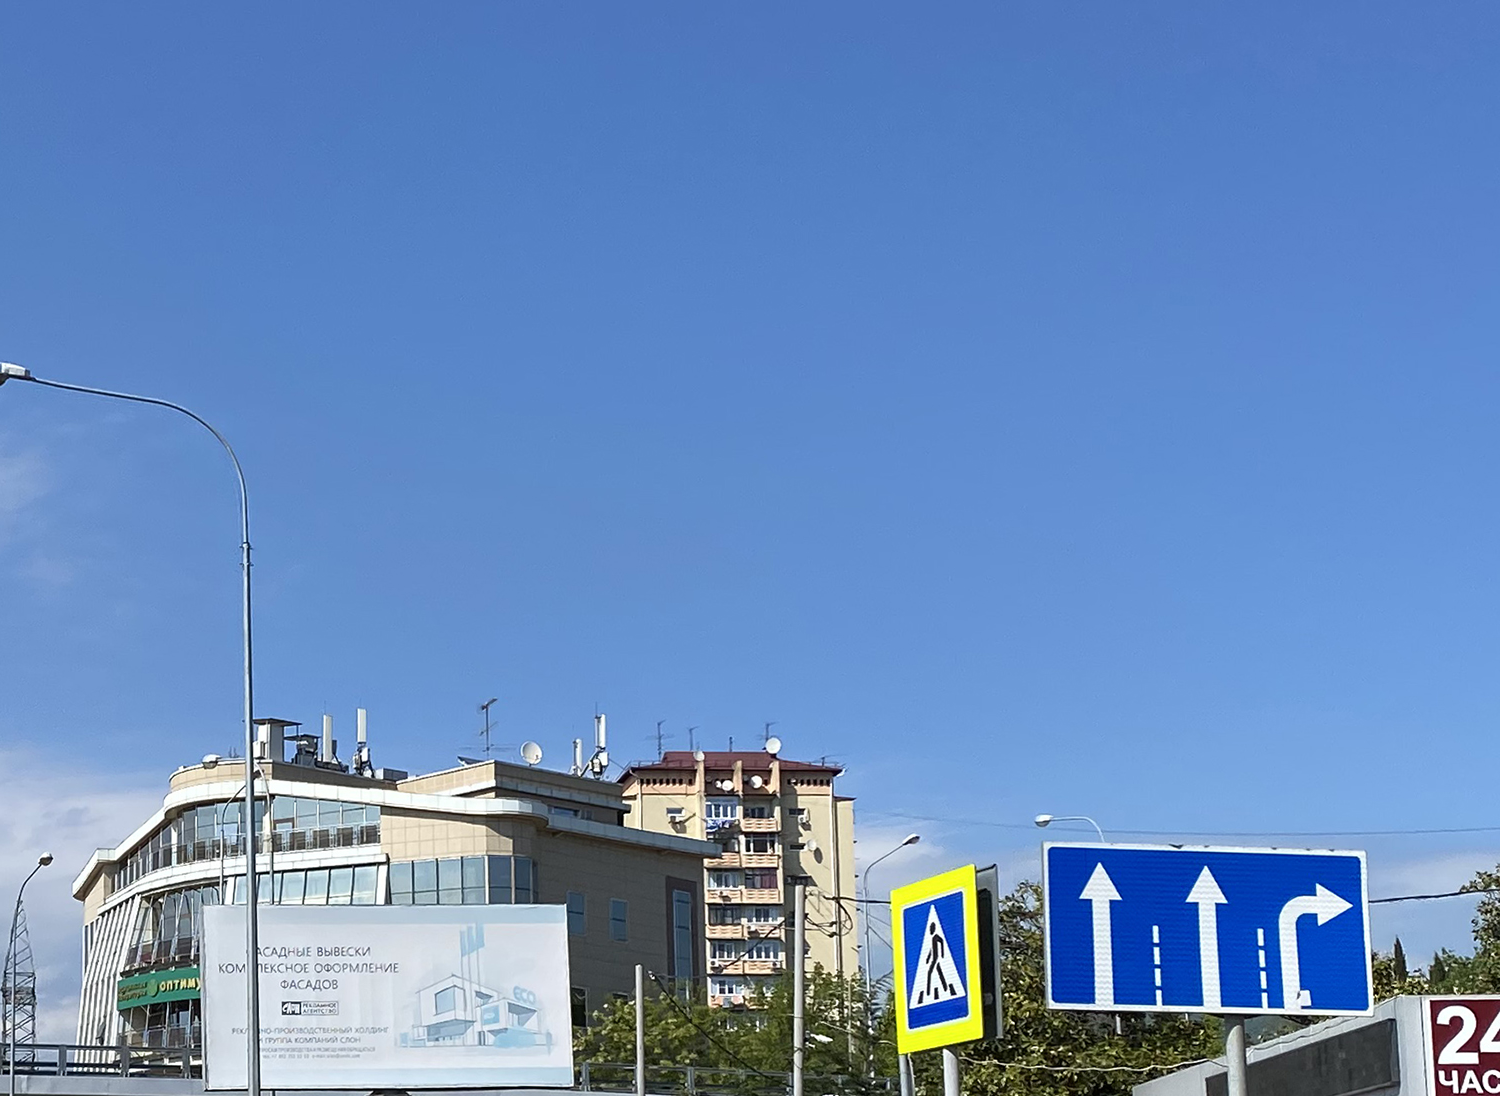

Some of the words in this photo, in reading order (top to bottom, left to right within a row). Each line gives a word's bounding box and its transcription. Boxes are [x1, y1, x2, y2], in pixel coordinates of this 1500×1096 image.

[247, 947, 312, 958] АСАДНЫЕ
[317, 947, 371, 957] ВЫВЕСКИ
[218, 963, 310, 974] КОМЛЕКСНОЕ
[314, 963, 399, 974] ОФОРМЛЕНИЕ
[280, 979, 339, 991] ФАСАДОВ
[231, 1026, 352, 1036] РЕКЛНО-ПРОИЗВОДСТВЕННЫЙ
